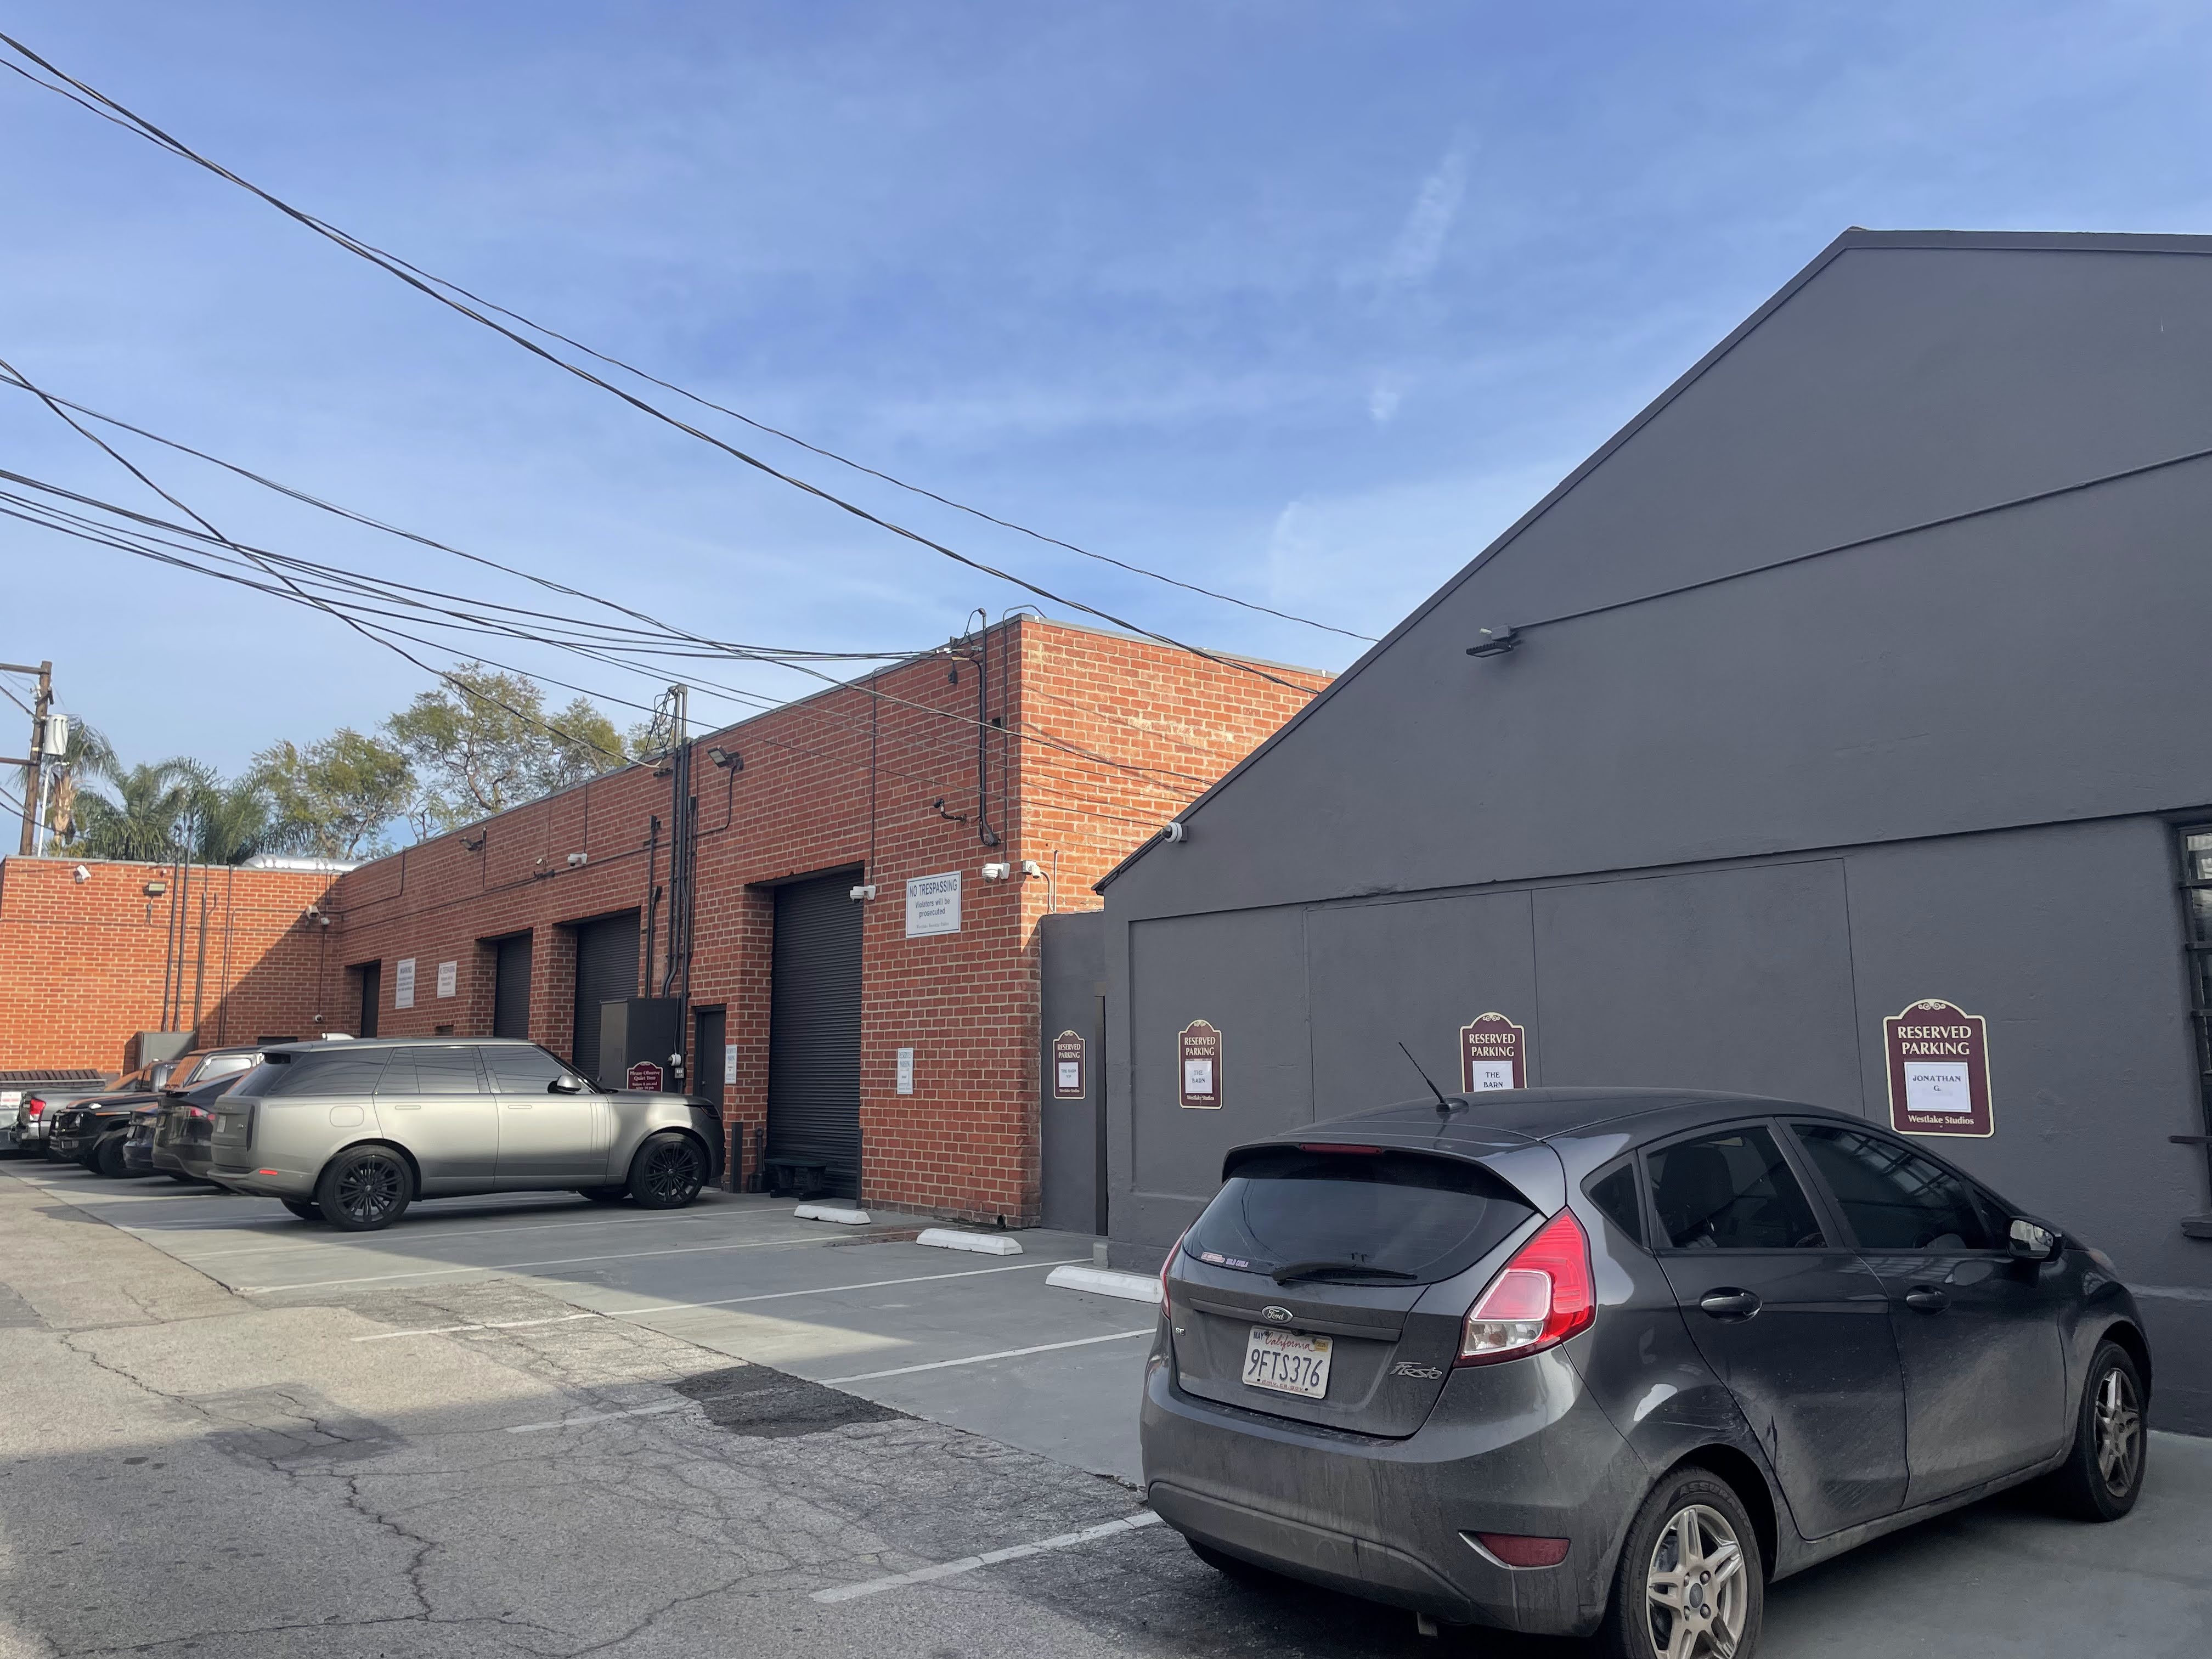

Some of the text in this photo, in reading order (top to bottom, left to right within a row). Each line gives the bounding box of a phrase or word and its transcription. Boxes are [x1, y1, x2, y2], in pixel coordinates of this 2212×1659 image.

[910, 879, 957, 897] NO TRESPASSING
[915, 900, 934, 909] Violators
[919, 907, 946, 919] prosecuted
[1897, 1026, 1972, 1039] RESERVED
[1184, 1036, 1216, 1046] RESERVED
[1469, 1034, 1516, 1044] RESERVED
[1186, 1047, 1215, 1056] PARKING
[1471, 1046, 1514, 1057] PARKING
[1901, 1042, 1970, 1055] PARKING
[1908, 1115, 1974, 1125] Westlake Studios
[1267, 1308, 1284, 1321] Ford
[1175, 1327, 1185, 1335] SE
[1253, 1331, 1265, 1340] MAY
[1265, 1332, 1316, 1352] California
[1248, 1348, 1323, 1387] 9FTS376
[1389, 1362, 1442, 1380] Fiesta
[1261, 1379, 1304, 1391] dmv.ca.gov
